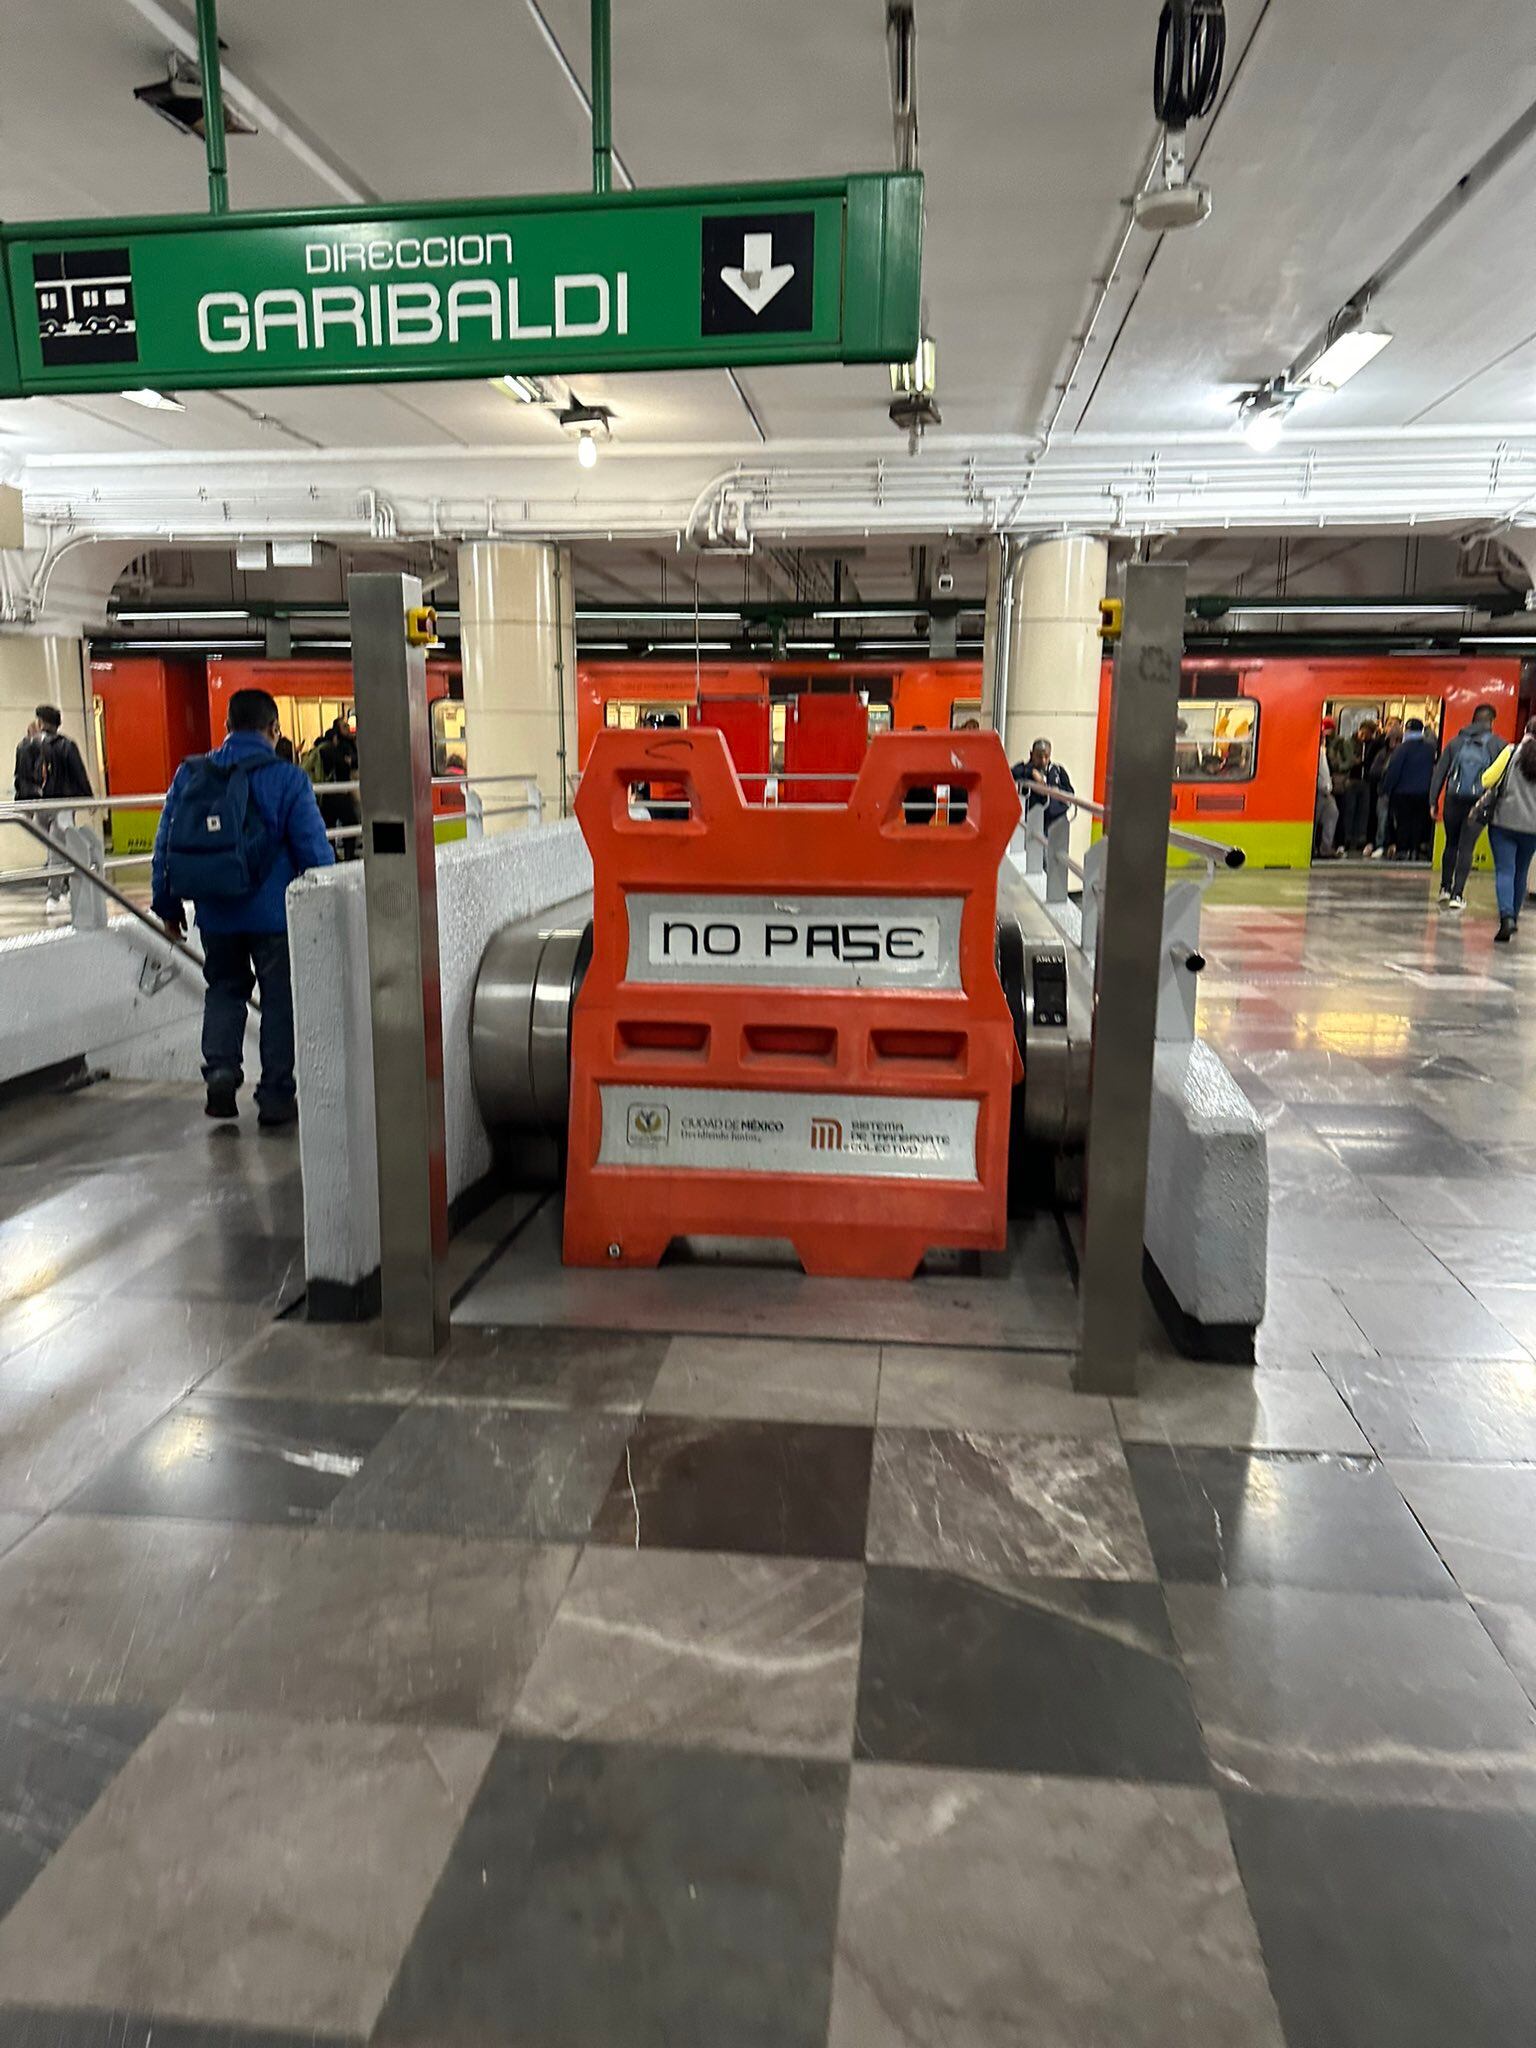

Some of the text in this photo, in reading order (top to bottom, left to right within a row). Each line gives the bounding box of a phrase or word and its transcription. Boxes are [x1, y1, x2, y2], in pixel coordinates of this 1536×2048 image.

[305, 233, 514, 275] DIRECCION
[198, 271, 629, 355] GARIBALDI
[662, 921, 925, 962] NO PASE
